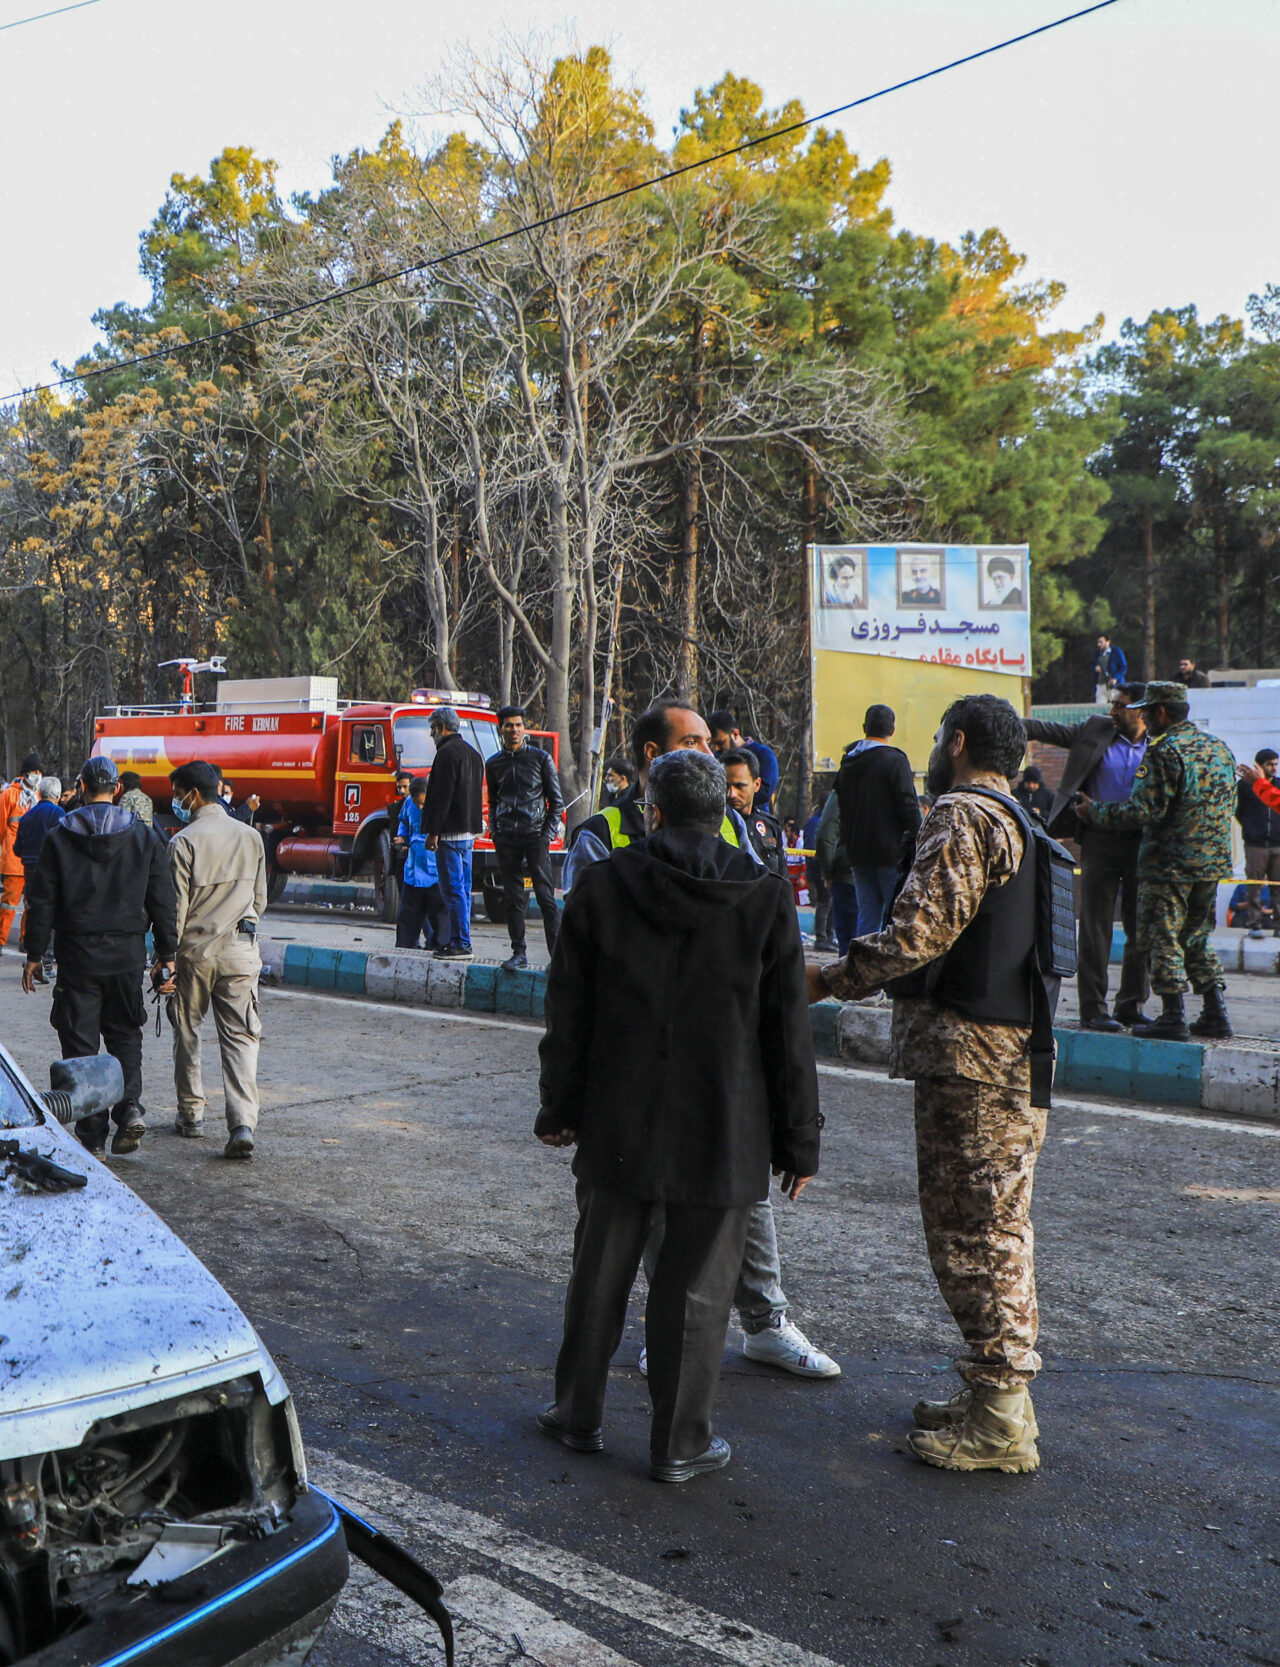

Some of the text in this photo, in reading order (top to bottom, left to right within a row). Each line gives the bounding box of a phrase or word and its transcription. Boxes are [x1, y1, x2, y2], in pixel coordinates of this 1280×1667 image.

[851, 612, 1000, 641] مسجد فروزی
[965, 646, 1026, 672] پایگاه
[224, 715, 280, 732] FIRE KERMAN
[344, 812, 360, 823] 125
